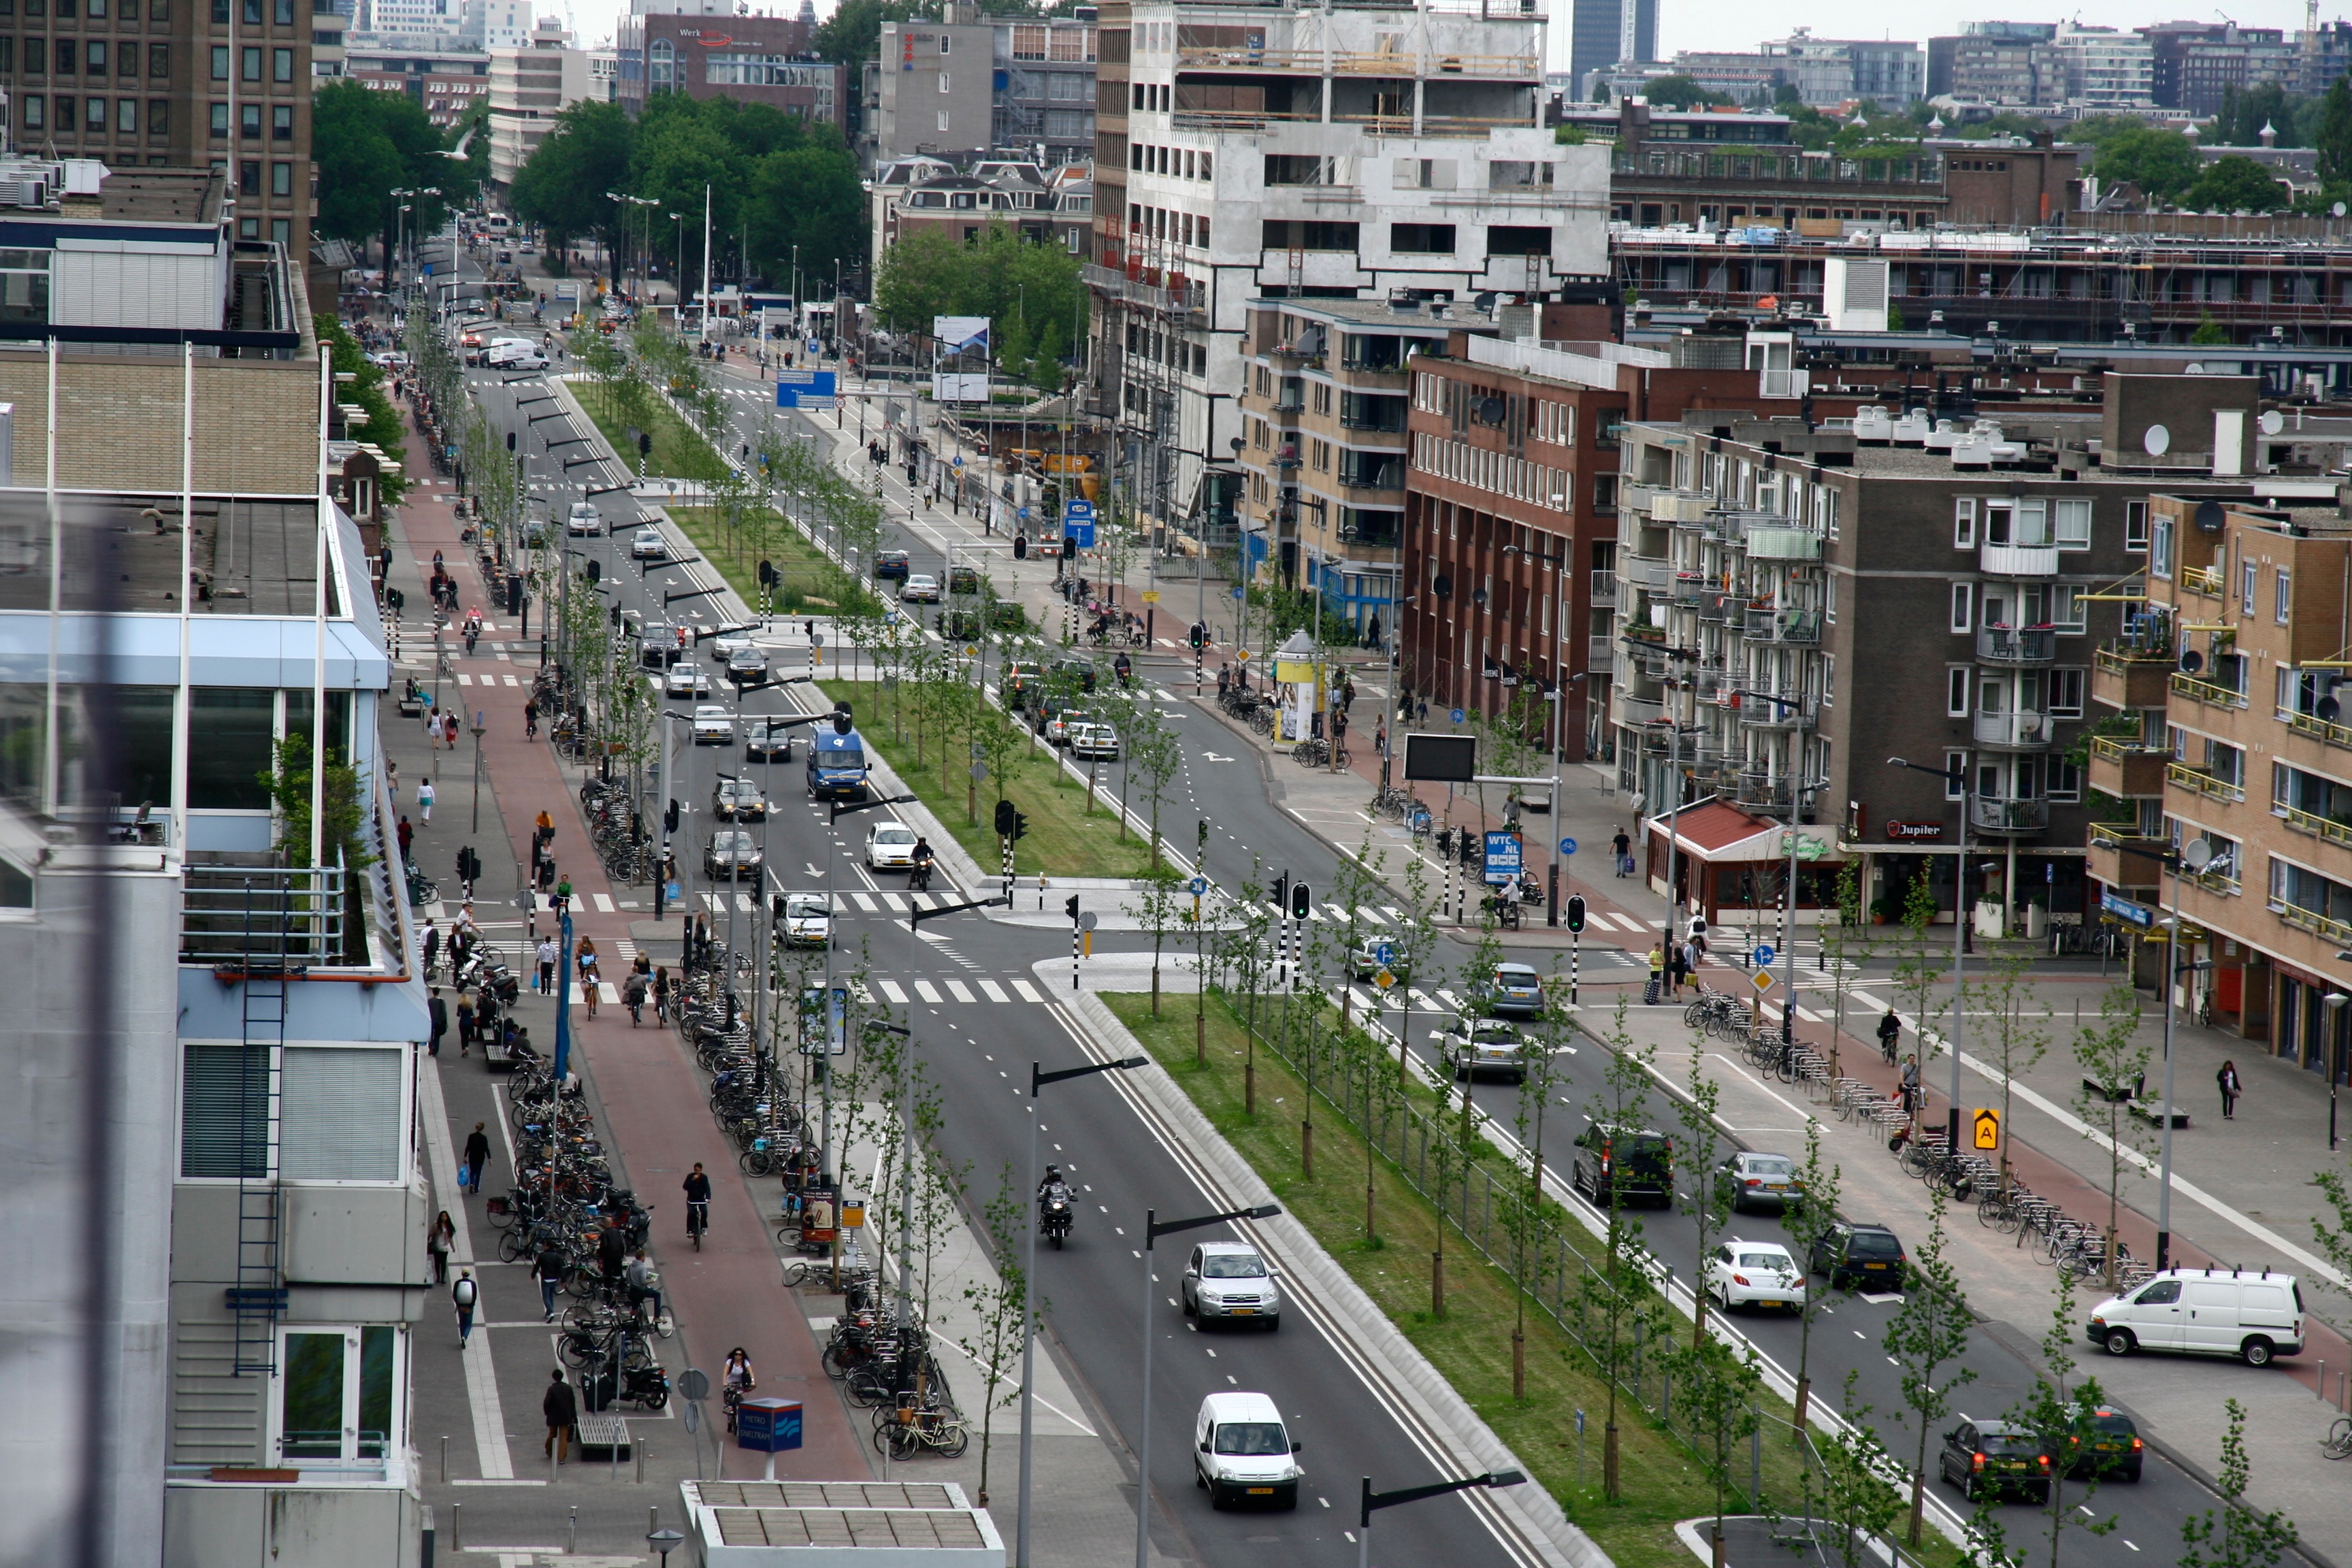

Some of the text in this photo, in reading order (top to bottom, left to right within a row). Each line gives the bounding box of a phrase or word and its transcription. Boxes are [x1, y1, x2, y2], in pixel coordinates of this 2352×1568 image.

[1900, 825, 1940, 836] Jupiler
[1488, 836, 1512, 845] WTC
[1503, 845, 1519, 854] .NL
[1980, 1127, 1993, 1140] A
[745, 1415, 766, 1424] METRO
[740, 1429, 770, 1441] SNELTRAM
